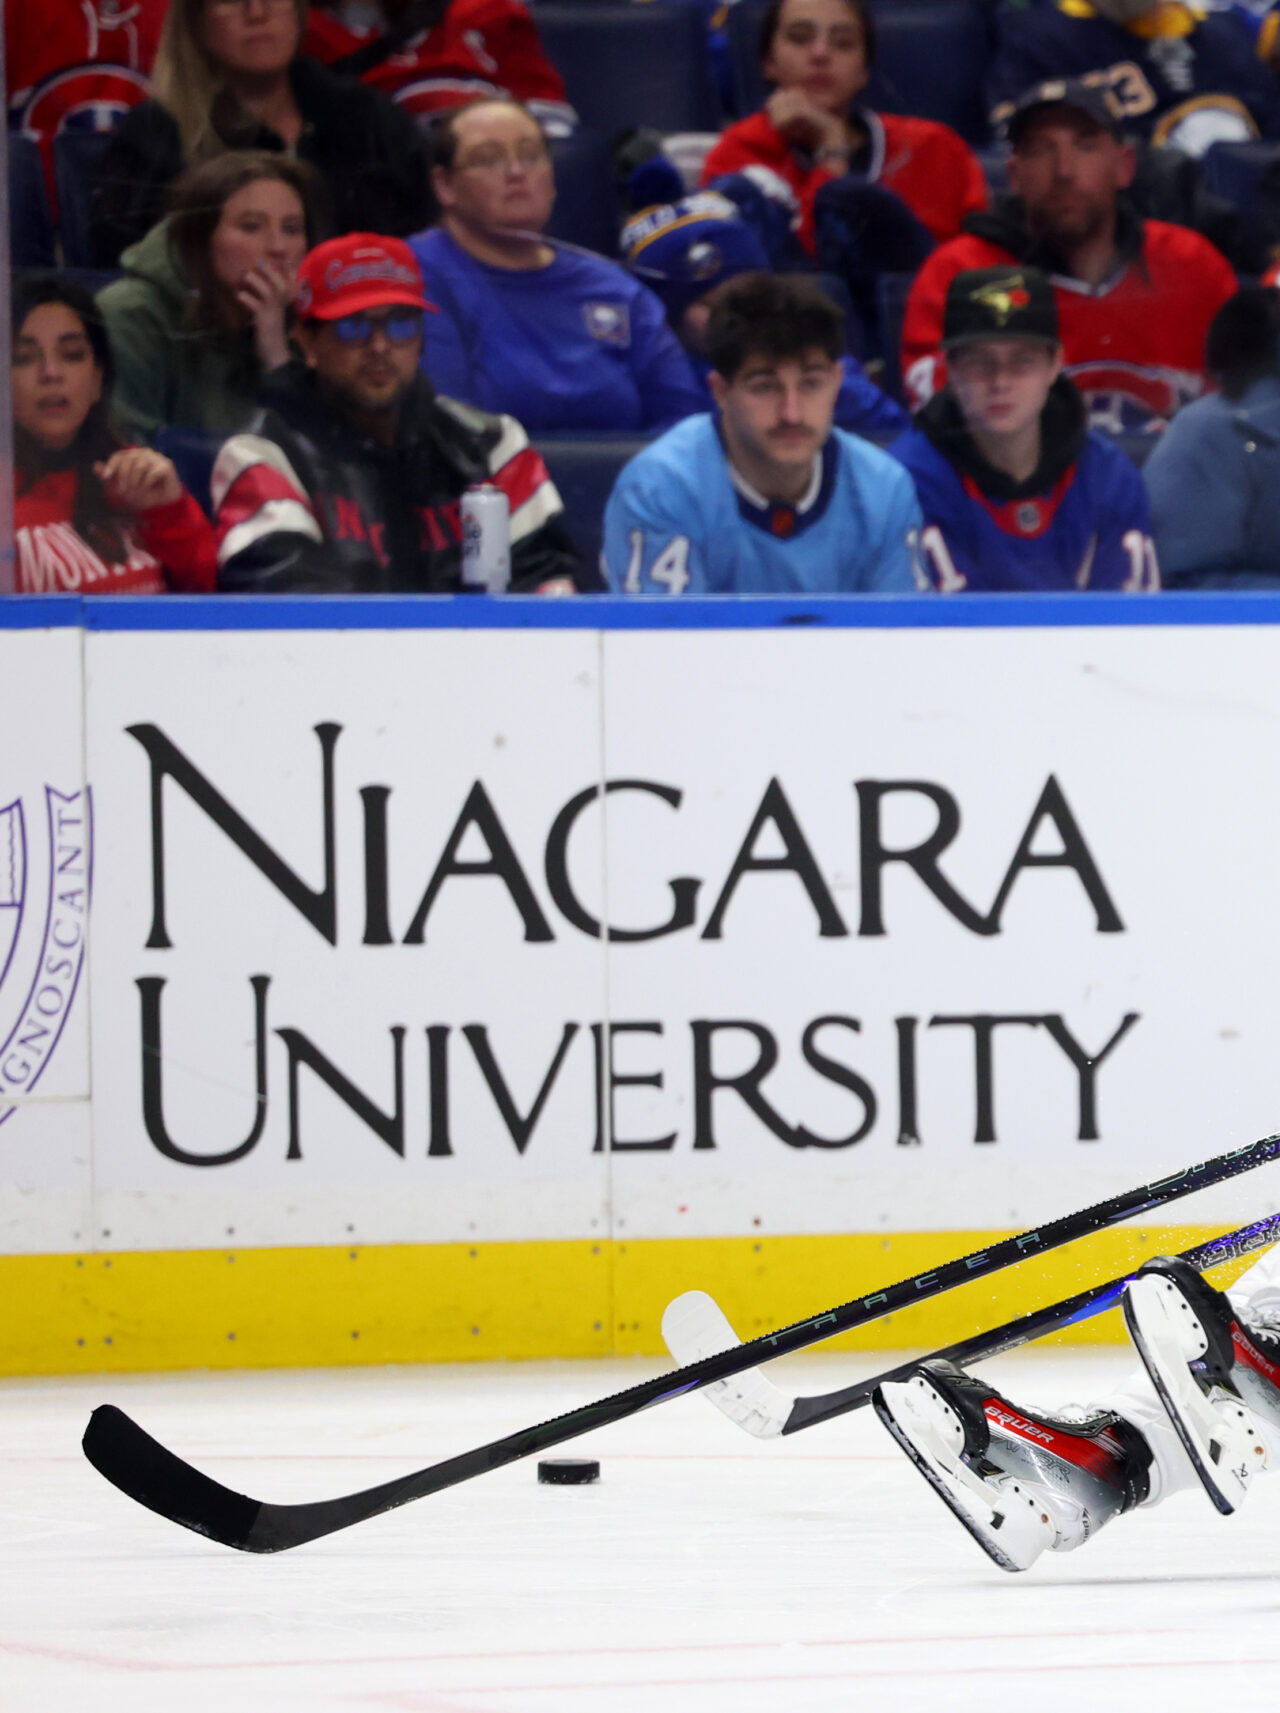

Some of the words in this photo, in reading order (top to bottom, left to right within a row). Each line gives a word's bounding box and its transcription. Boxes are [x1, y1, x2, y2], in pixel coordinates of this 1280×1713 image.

[624, 528, 690, 595] 14
[124, 722, 1126, 949] NIAGARA
[135, 974, 1141, 1168] UNIVERSITY
[984, 1406, 1055, 1443] BAUER
